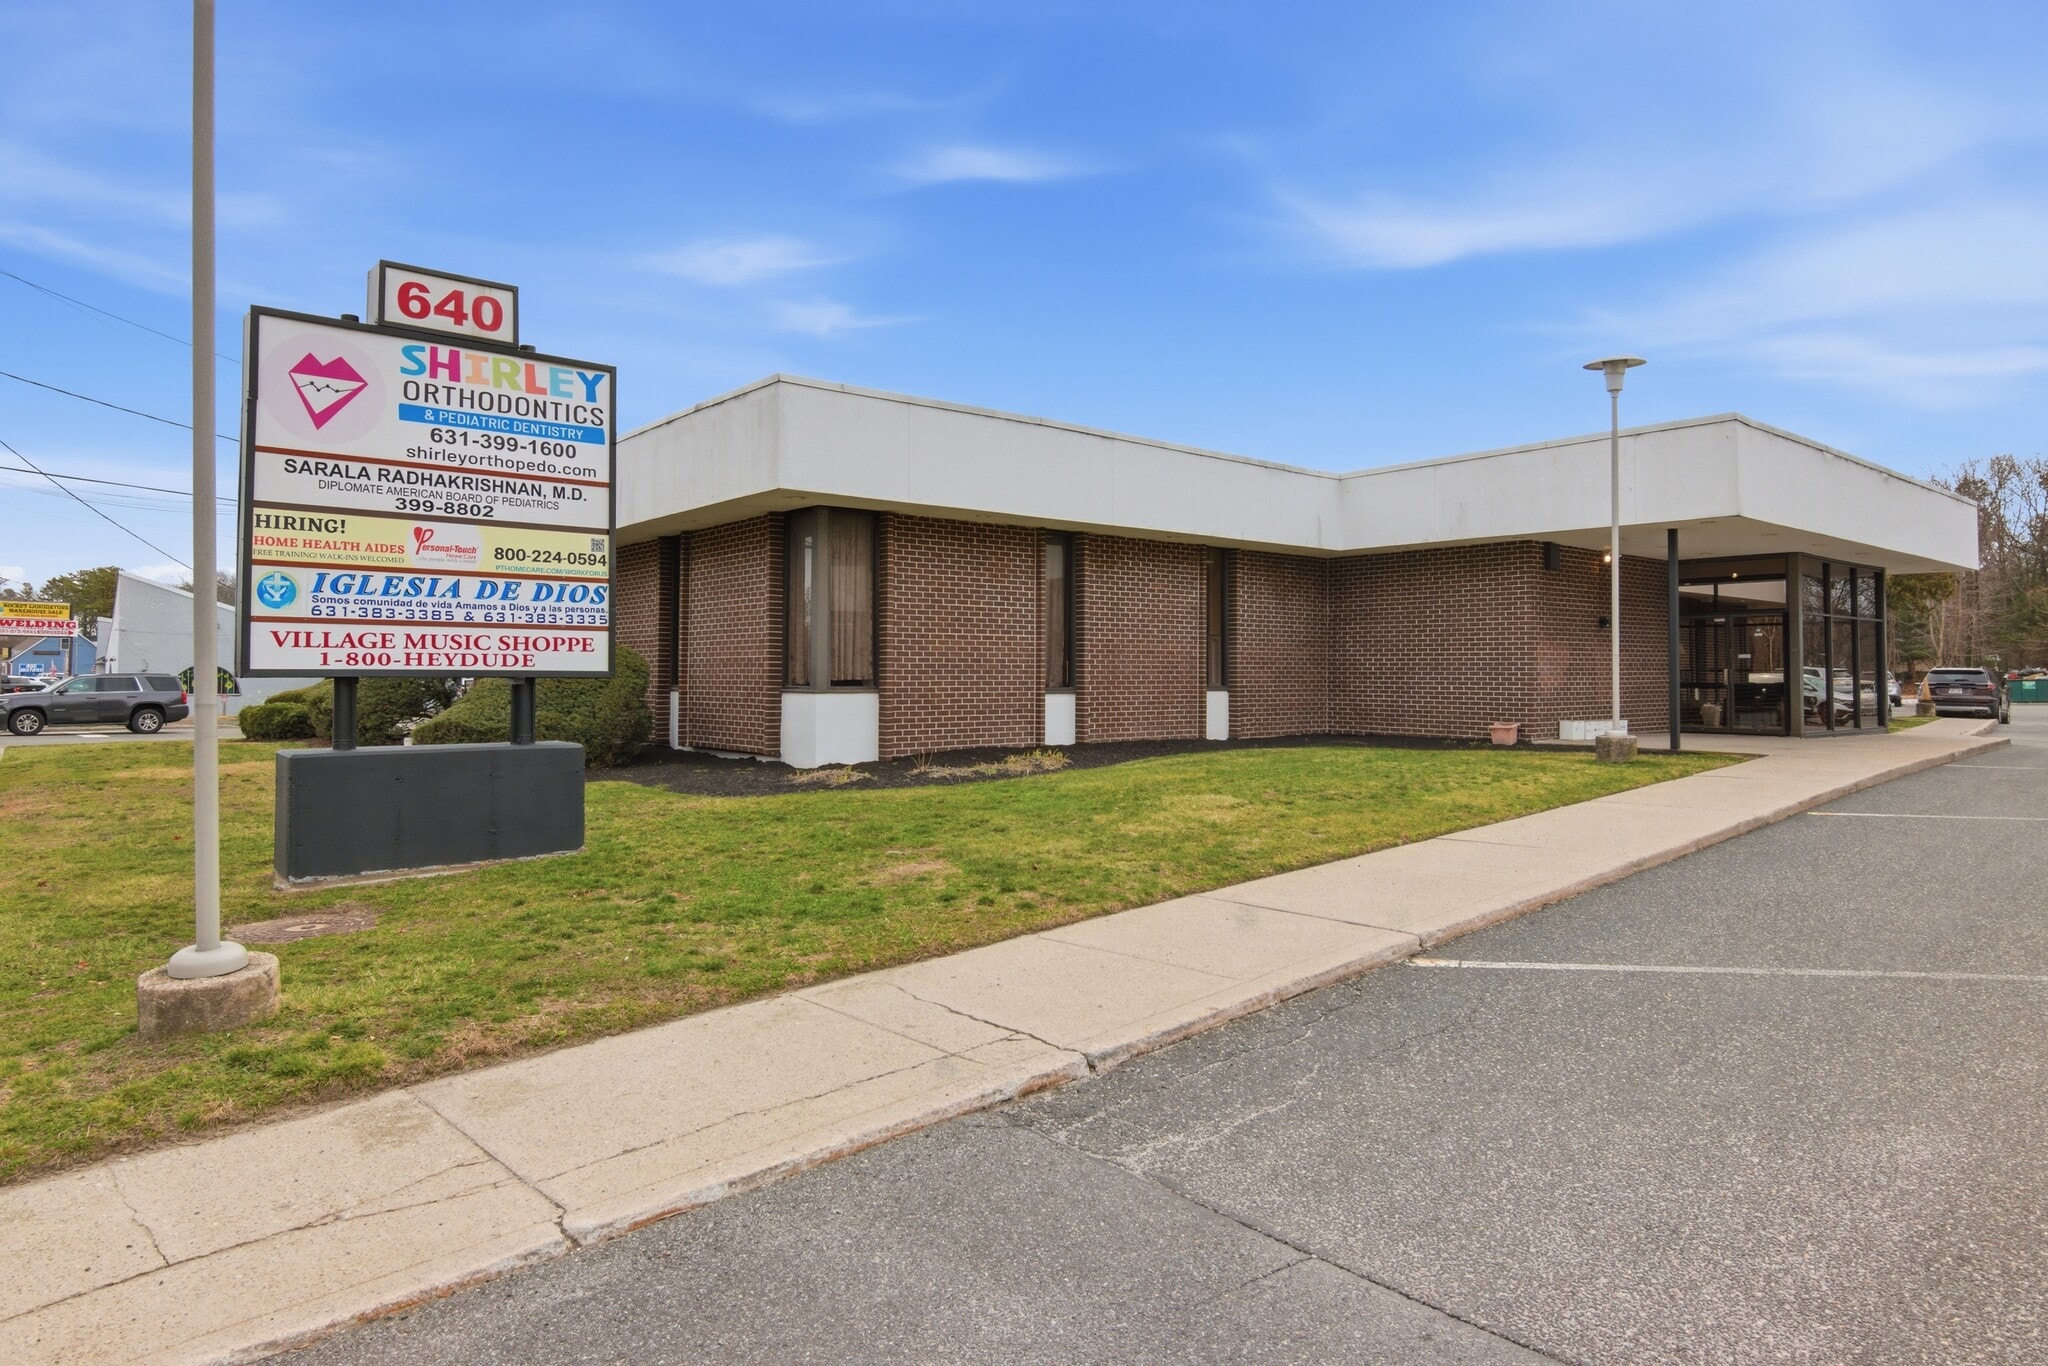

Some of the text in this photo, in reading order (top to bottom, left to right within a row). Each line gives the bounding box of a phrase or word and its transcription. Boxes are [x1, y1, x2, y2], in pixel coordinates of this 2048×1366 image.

[397, 281, 503, 332] 640
[400, 345, 605, 403] SHIRLEY
[403, 380, 604, 427] ORTHODONTICS
[424, 409, 584, 440] & PEDIATRIC DENTISTRY
[430, 428, 577, 459] 631-399-1600
[406, 446, 597, 478] shirleyorthopedo.com
[284, 458, 588, 502] SARALA RADHAKRISHNAN, M.D.
[318, 479, 560, 511] DIPLOMATE AMERICAN BOARD OF PEDIATRICS
[395, 498, 495, 518] 399-8802
[254, 514, 346, 534] HIRING!
[253, 535, 405, 555] HOME HEALTH AIDES
[415, 528, 478, 555] Personal-Touch
[253, 548, 405, 564] FREE TRAINING! WALK-INS WELCOMED
[494, 547, 607, 566] 800-224-0594
[310, 572, 608, 605] IGLESIA DE DIOS
[311, 595, 350, 604] Somos
[353, 598, 413, 607] comunidad
[415, 600, 428, 609] de
[431, 601, 452, 609] vida
[455, 601, 498, 611] Amamos
[509, 603, 530, 612] Dios
[564, 606, 609, 615] personas.
[311, 605, 608, 625] 631-383-3385 & 631-383-3335
[0, 619, 77, 629] WELDING
[270, 630, 595, 654] VILLAGE MUSIC SHOPPE
[319, 651, 536, 669] 1-800-HEYDUDE
